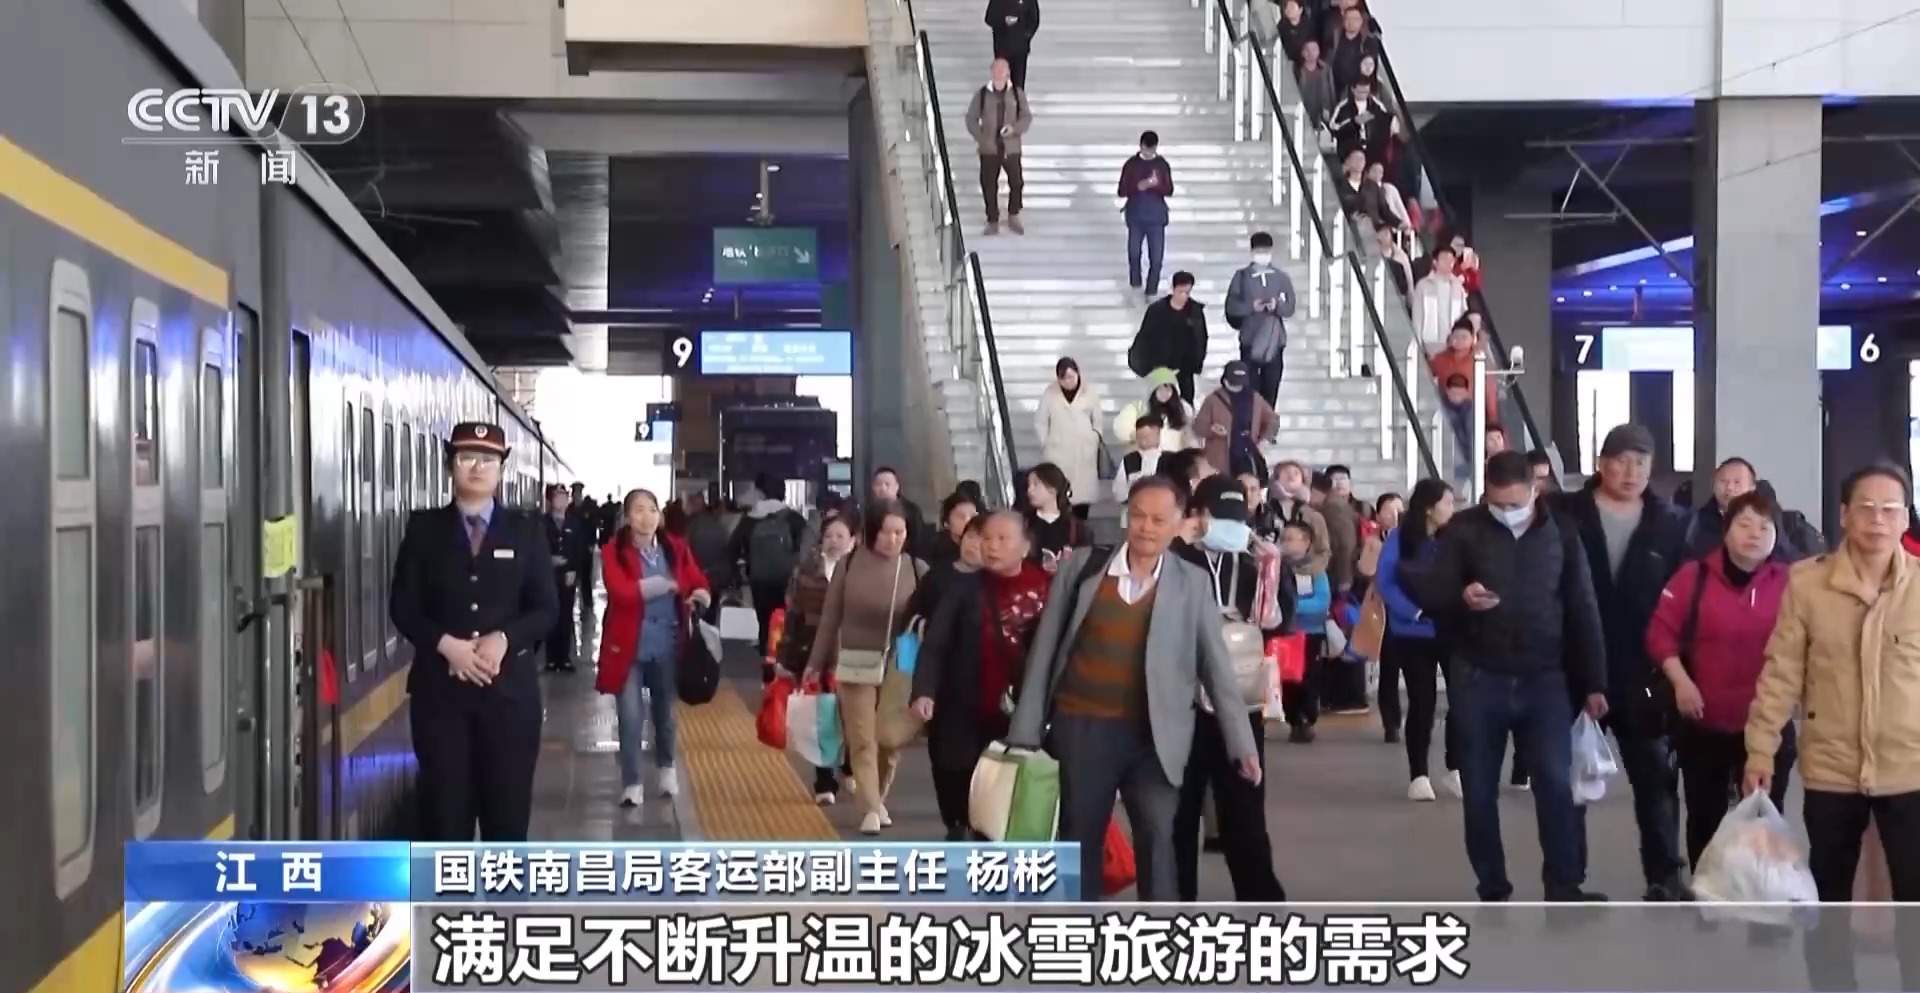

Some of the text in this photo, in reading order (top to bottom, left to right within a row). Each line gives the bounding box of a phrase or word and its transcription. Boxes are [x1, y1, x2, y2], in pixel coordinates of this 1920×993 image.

[672, 337, 693, 367] 9
[1575, 335, 1594, 364] 7
[1860, 333, 1880, 362] 6
